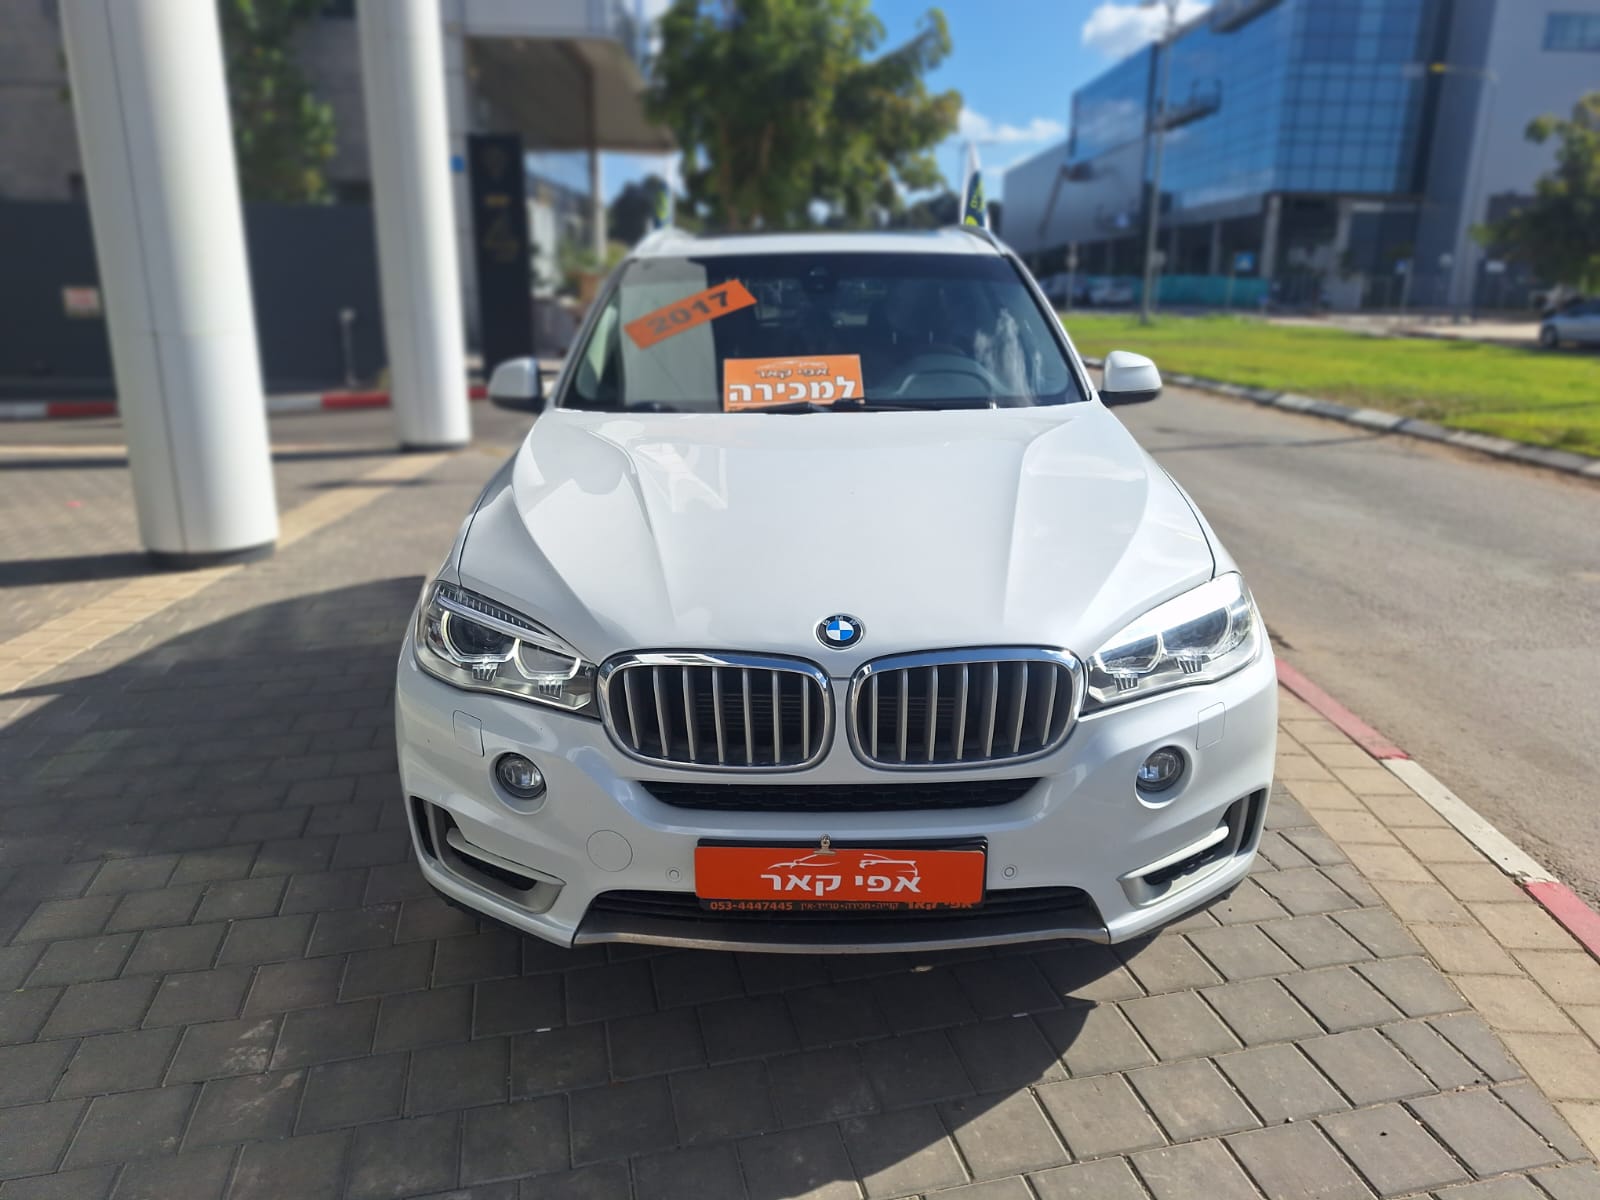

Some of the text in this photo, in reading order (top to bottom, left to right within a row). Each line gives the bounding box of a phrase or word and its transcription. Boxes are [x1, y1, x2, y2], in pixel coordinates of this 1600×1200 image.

[646, 290, 728, 336] 2017
[728, 376, 856, 402] למכירה
[760, 874, 921, 897] אפי קאר
[709, 901, 793, 911] 053-4447445
